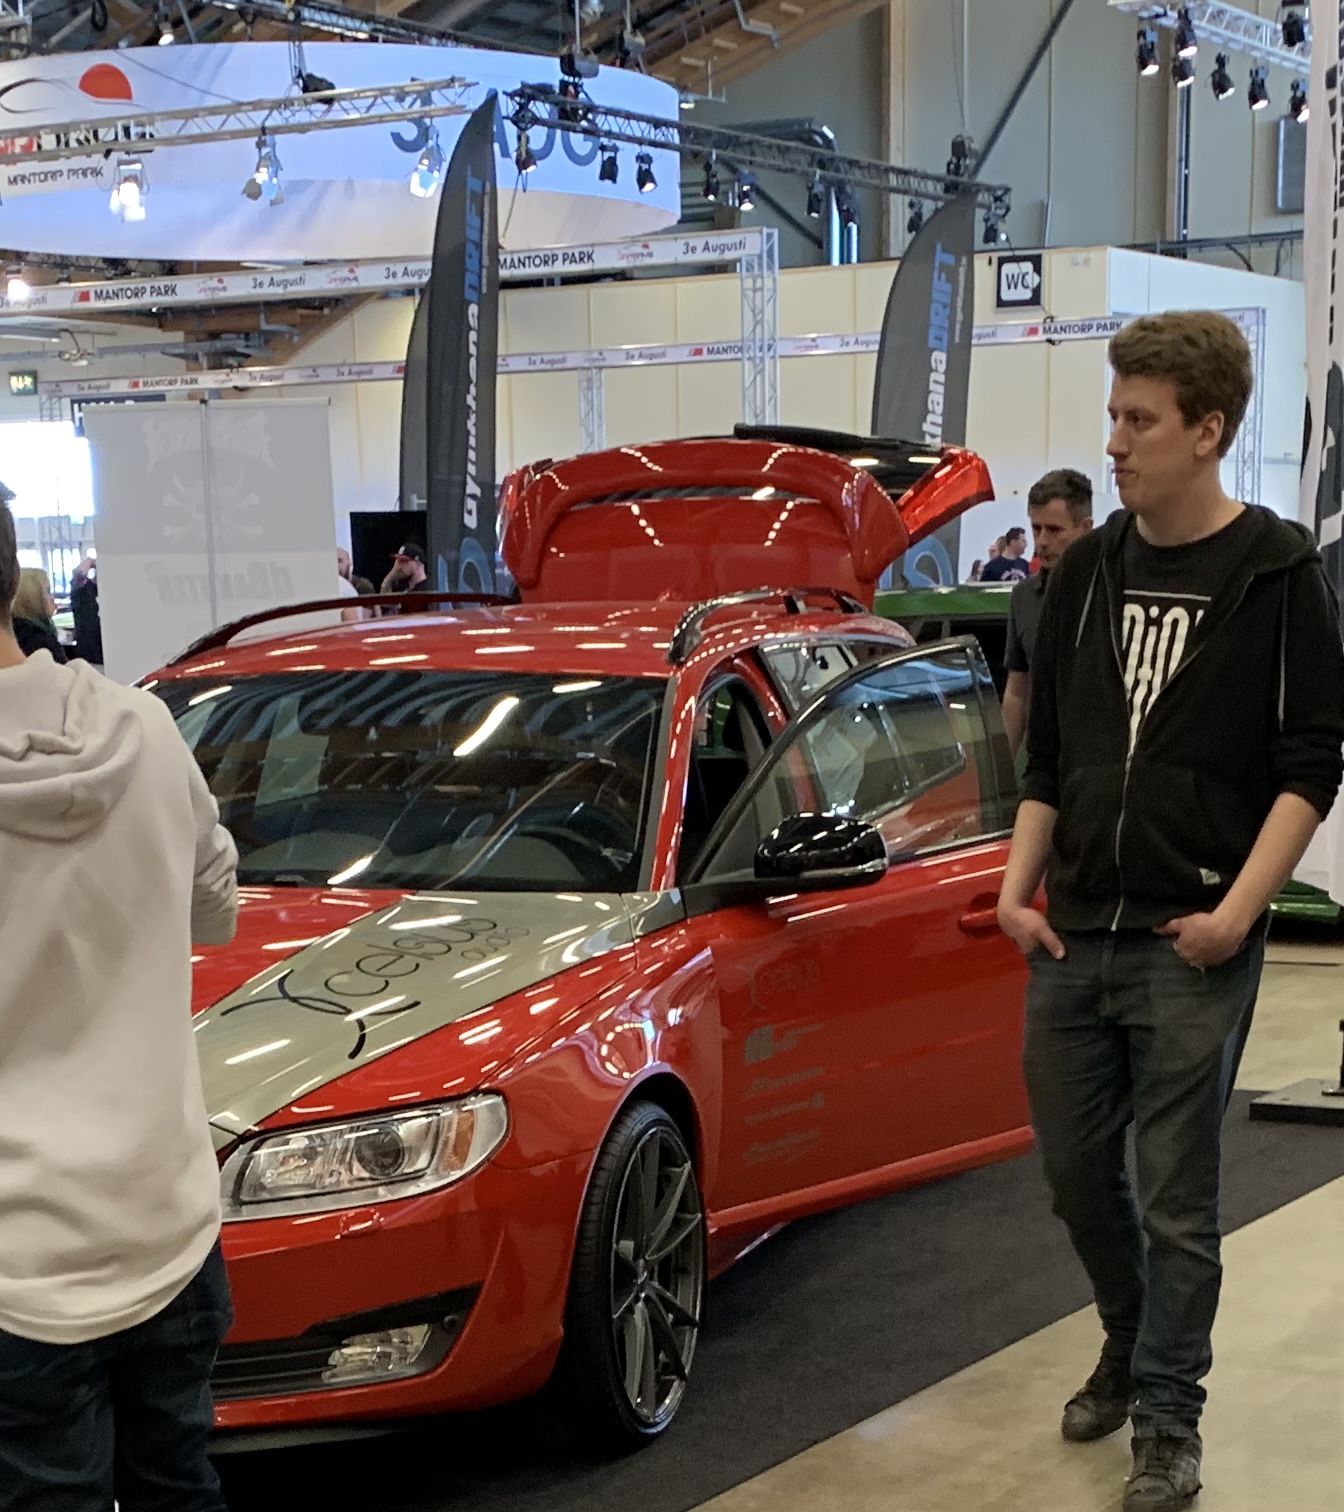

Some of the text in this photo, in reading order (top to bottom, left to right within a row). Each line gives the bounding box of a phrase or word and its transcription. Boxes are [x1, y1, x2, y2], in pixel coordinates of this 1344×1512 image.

[8, 166, 104, 186] MANTORP PARK
[682, 237, 747, 255] 3e Augusti
[498, 250, 595, 271] MANTORP PARK
[384, 265, 431, 281] 3e Augu
[1005, 272, 1031, 291] WC
[94, 283, 178, 302] MANTORP PARK
[252, 276, 305, 293] 3e Augusti
[1042, 322, 1093, 336] MANTORP
